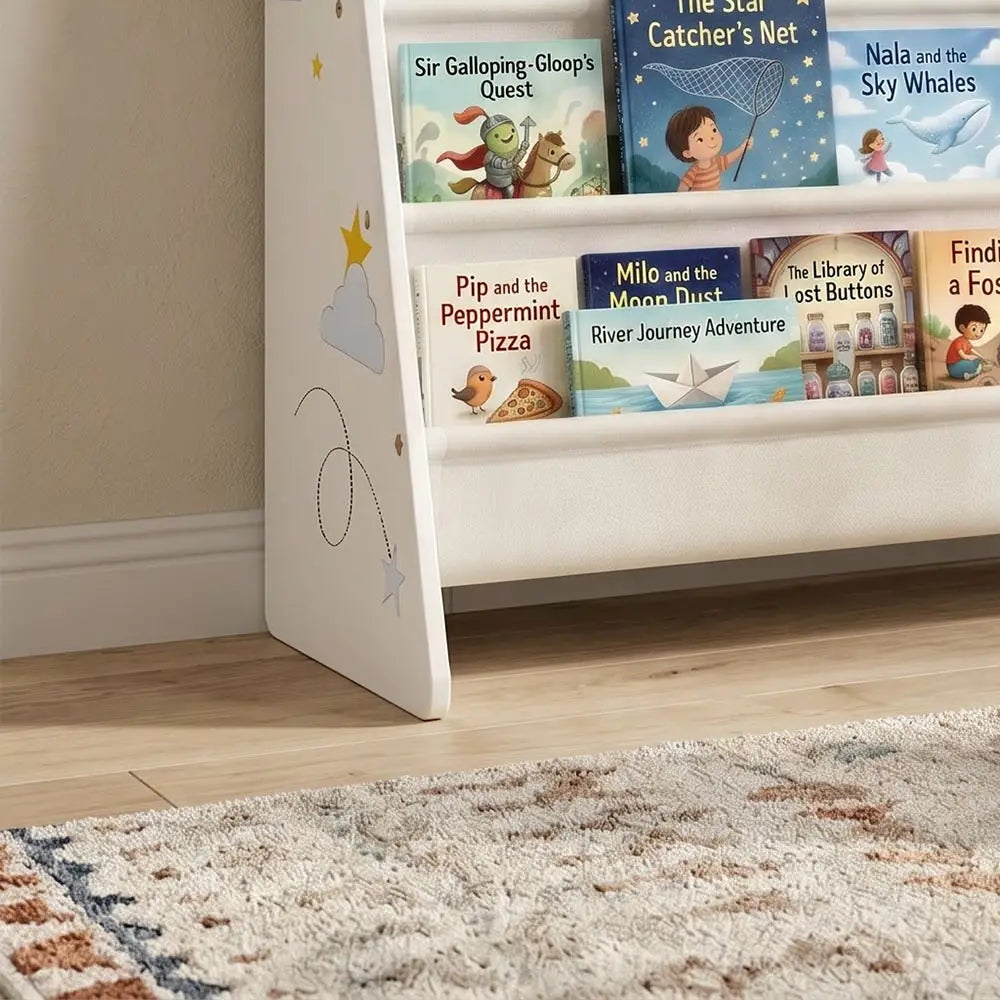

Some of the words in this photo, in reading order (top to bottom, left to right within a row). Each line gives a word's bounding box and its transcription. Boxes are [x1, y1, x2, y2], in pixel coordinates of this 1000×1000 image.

[760, 20, 798, 44] Net
[415, 57, 441, 77] Sir
[445, 53, 595, 79] Galloping-Gloop's
[866, 42, 911, 66] Nala
[917, 50, 941, 63] and
[946, 48, 967, 62] the
[480, 80, 533, 101] Quest
[861, 72, 898, 102] Sky
[904, 71, 976, 94] Whales
[617, 260, 659, 285] Milo
[665, 266, 690, 282] and
[694, 265, 717, 280] the
[788, 266, 808, 279] The
[813, 260, 866, 281] Library
[872, 260, 884, 275] of
[456, 275, 488, 301] Pip
[494, 279, 519, 294] and
[524, 278, 548, 293] the
[610, 291, 667, 309] Moon
[676, 286, 722, 305] Dust
[826, 282, 893, 301] Buttons
[949, 276, 960, 295] a
[441, 300, 561, 328] Peppermint
[476, 329, 531, 352] Pizza
[591, 325, 633, 344] River
[636, 318, 701, 343] Journey
[705, 318, 786, 336] Adventure
